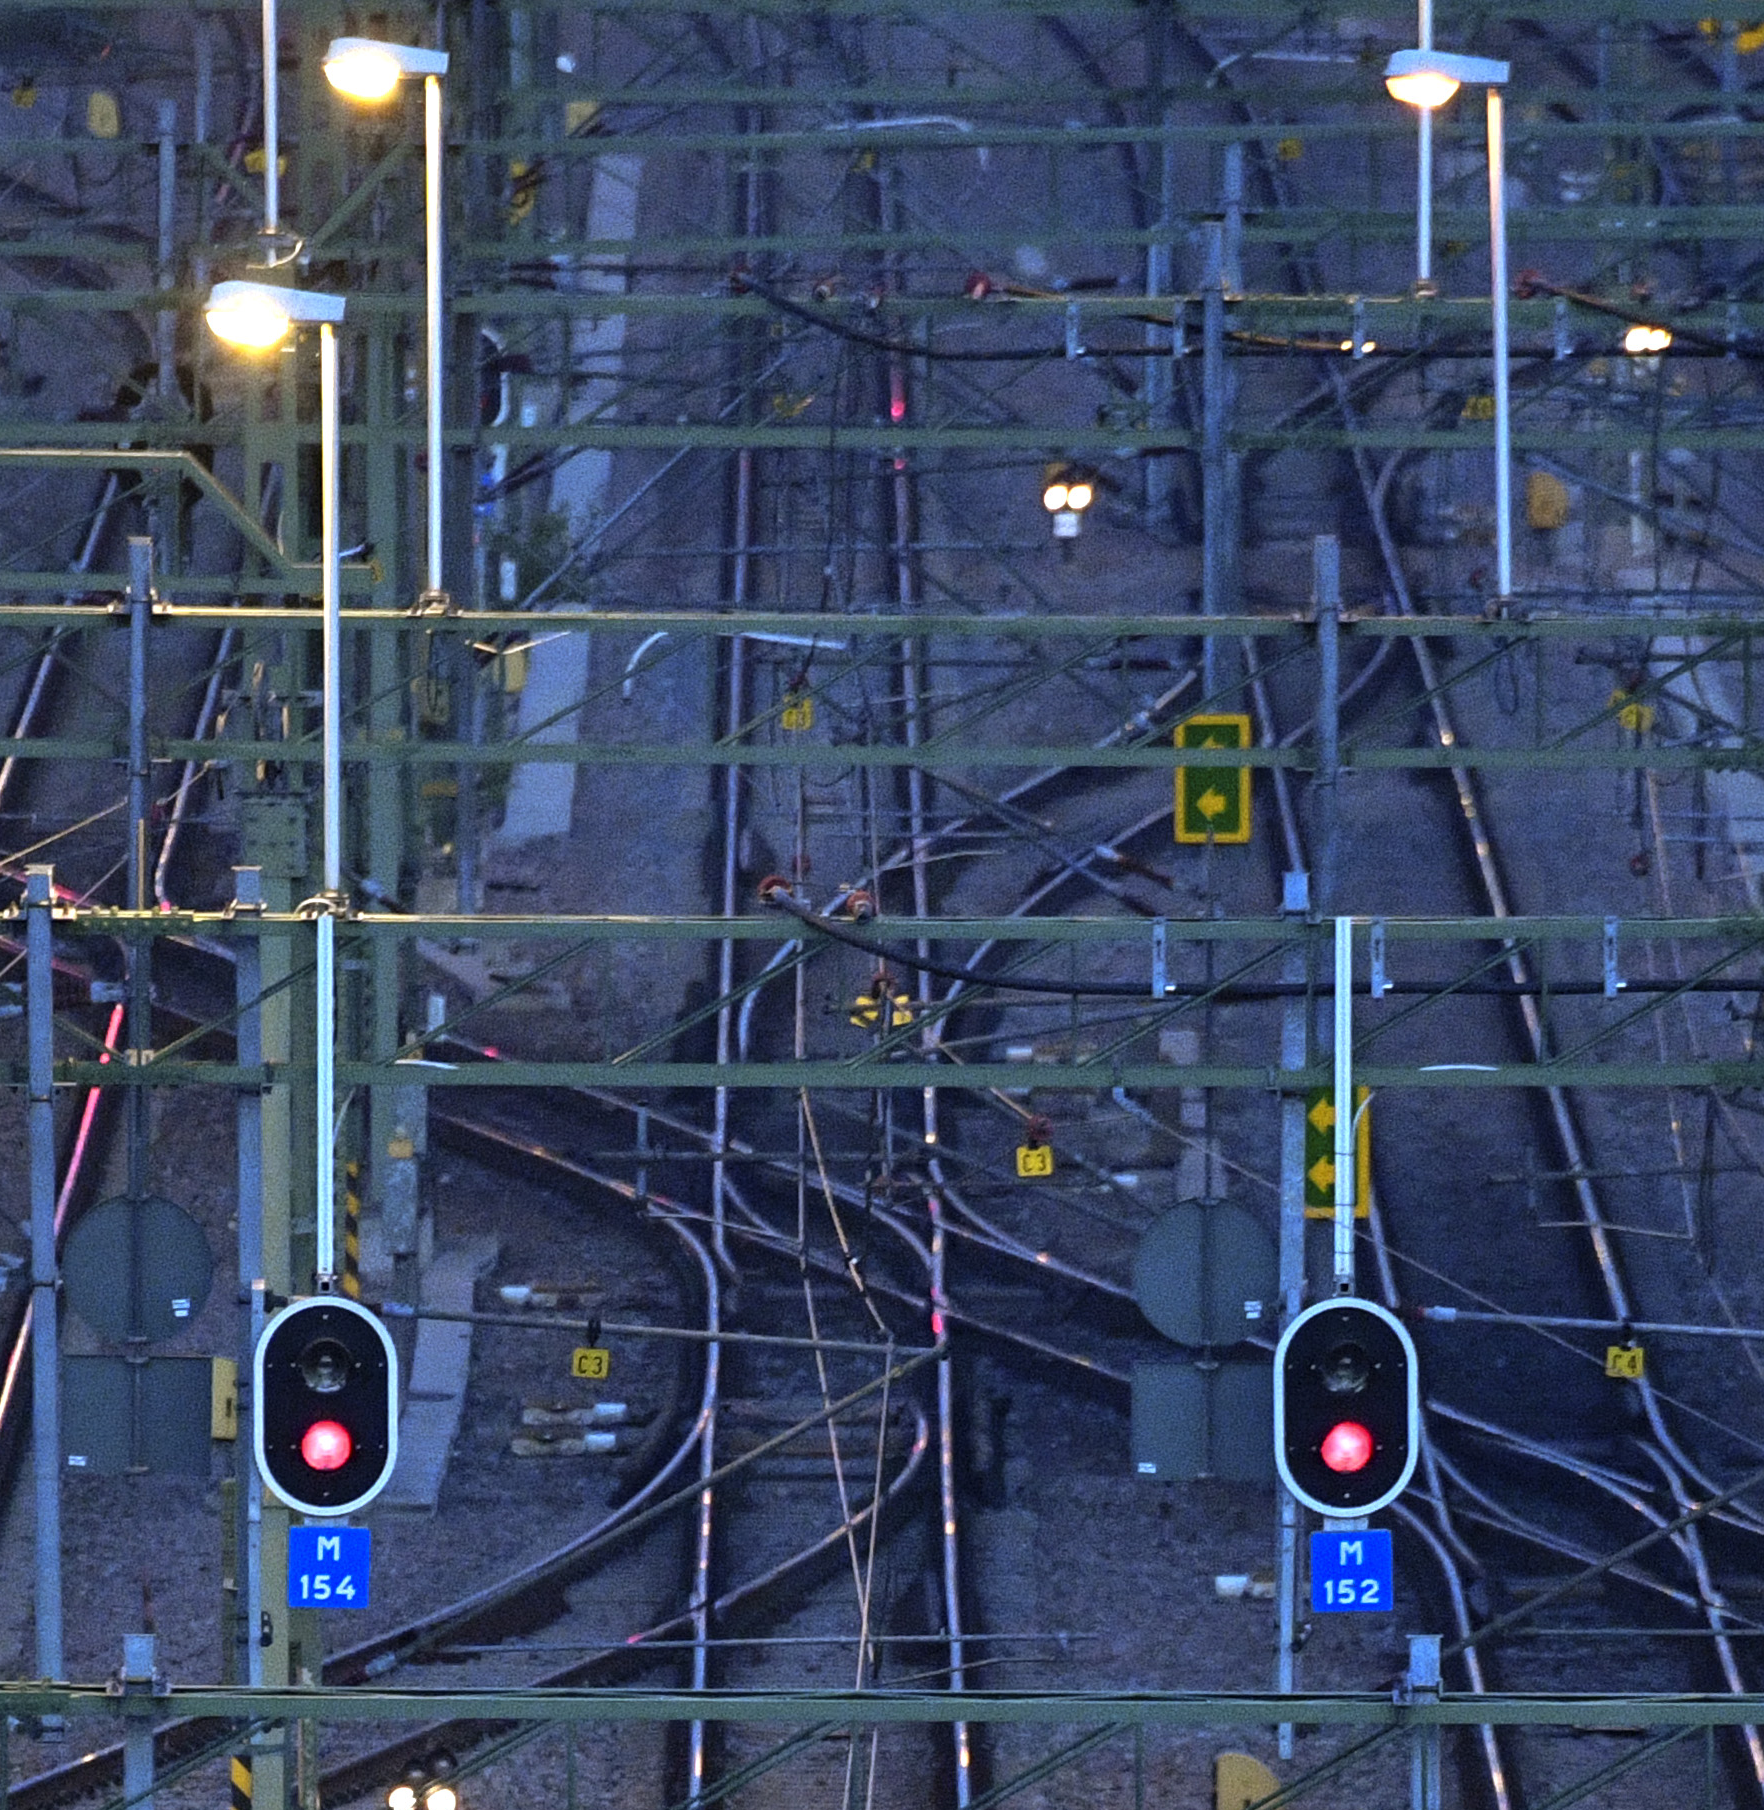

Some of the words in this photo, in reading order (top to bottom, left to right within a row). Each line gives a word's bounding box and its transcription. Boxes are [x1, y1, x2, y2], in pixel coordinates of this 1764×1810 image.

[317, 1536, 340, 1561] M
[1340, 1540, 1363, 1565] M
[300, 1574, 356, 1600] 154
[1324, 1579, 1379, 1604] 152
